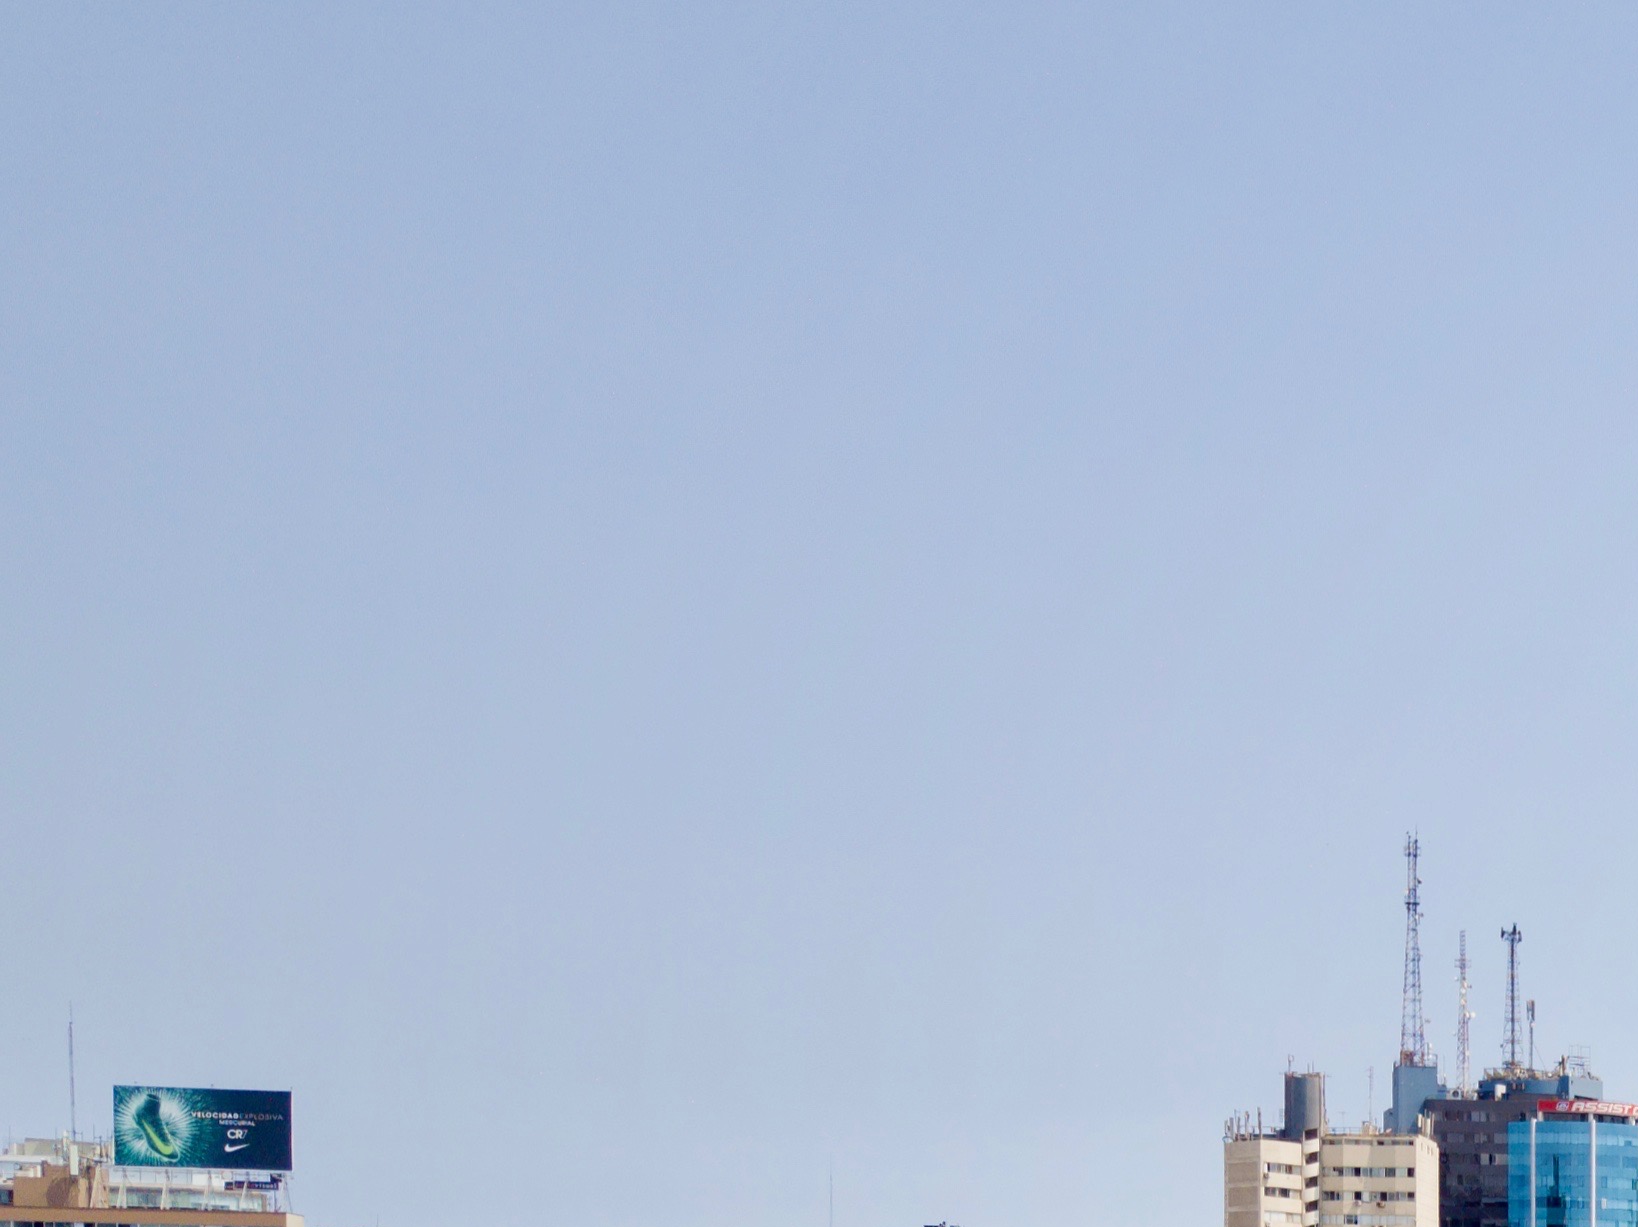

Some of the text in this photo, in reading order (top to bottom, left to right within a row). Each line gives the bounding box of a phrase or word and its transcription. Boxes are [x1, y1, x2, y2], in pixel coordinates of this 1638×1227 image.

[1572, 1102, 1632, 1115] ASSIST
[191, 1111, 283, 1120] VELOCIDAD EXPLOSIVA
[227, 1129, 248, 1139] CR7
